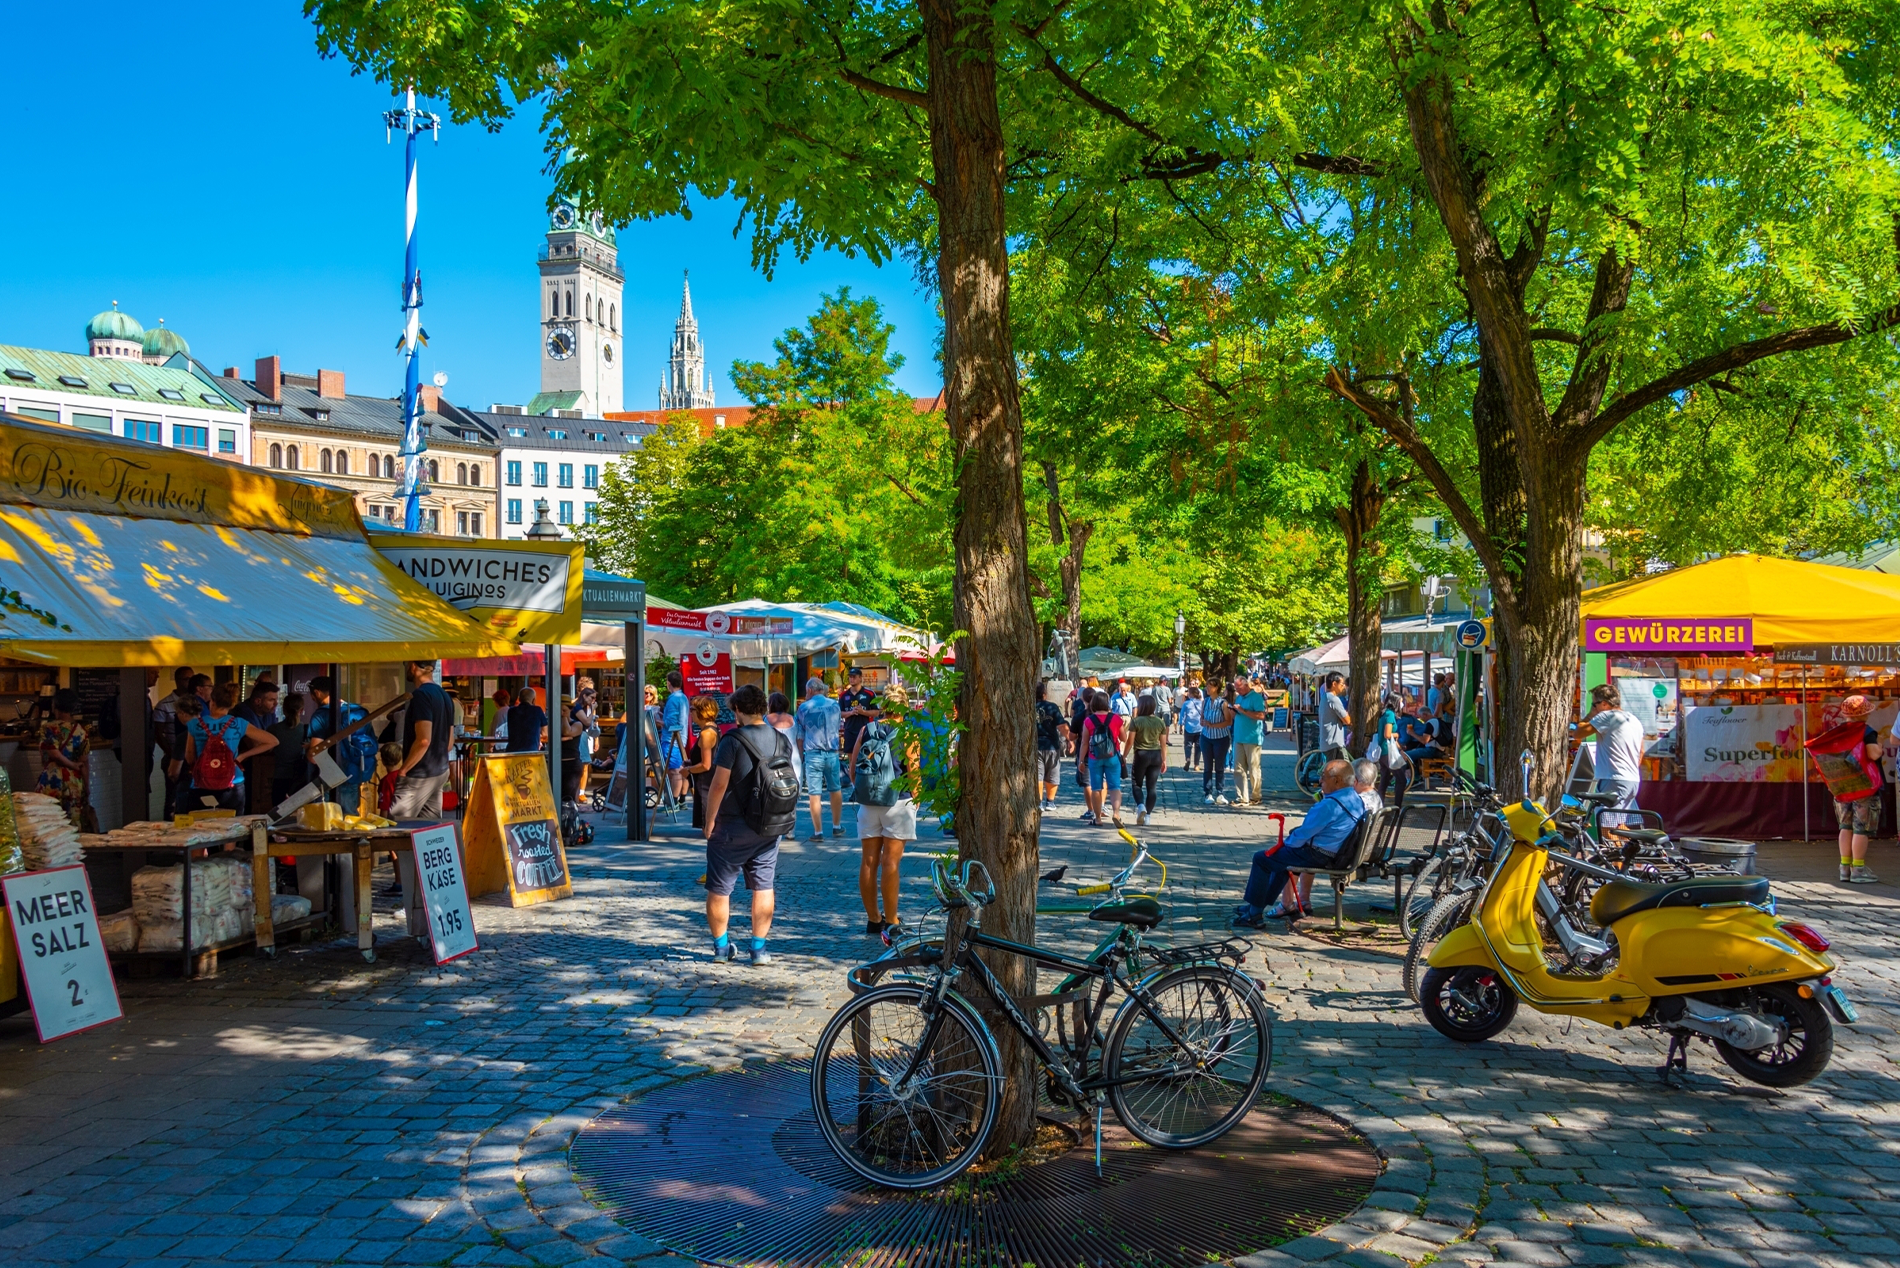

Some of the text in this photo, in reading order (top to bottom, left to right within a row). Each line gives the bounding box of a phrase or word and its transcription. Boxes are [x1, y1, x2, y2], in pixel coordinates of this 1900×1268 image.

[10, 443, 211, 513] Bio Feinkost
[1594, 622, 1744, 643] GEWÜRZEREI
[1702, 716, 1747, 726] Teaflower
[1704, 745, 1813, 764] Superfoo
[512, 806, 542, 818] MARKT
[511, 822, 551, 848] Fresh
[423, 847, 452, 870] BERG
[518, 844, 553, 859] roasted
[428, 868, 456, 892] KÄSE
[516, 855, 564, 886] COFFEE
[16, 890, 88, 926] MEER
[32, 922, 90, 958] SALZ
[67, 979, 84, 1006] 2
